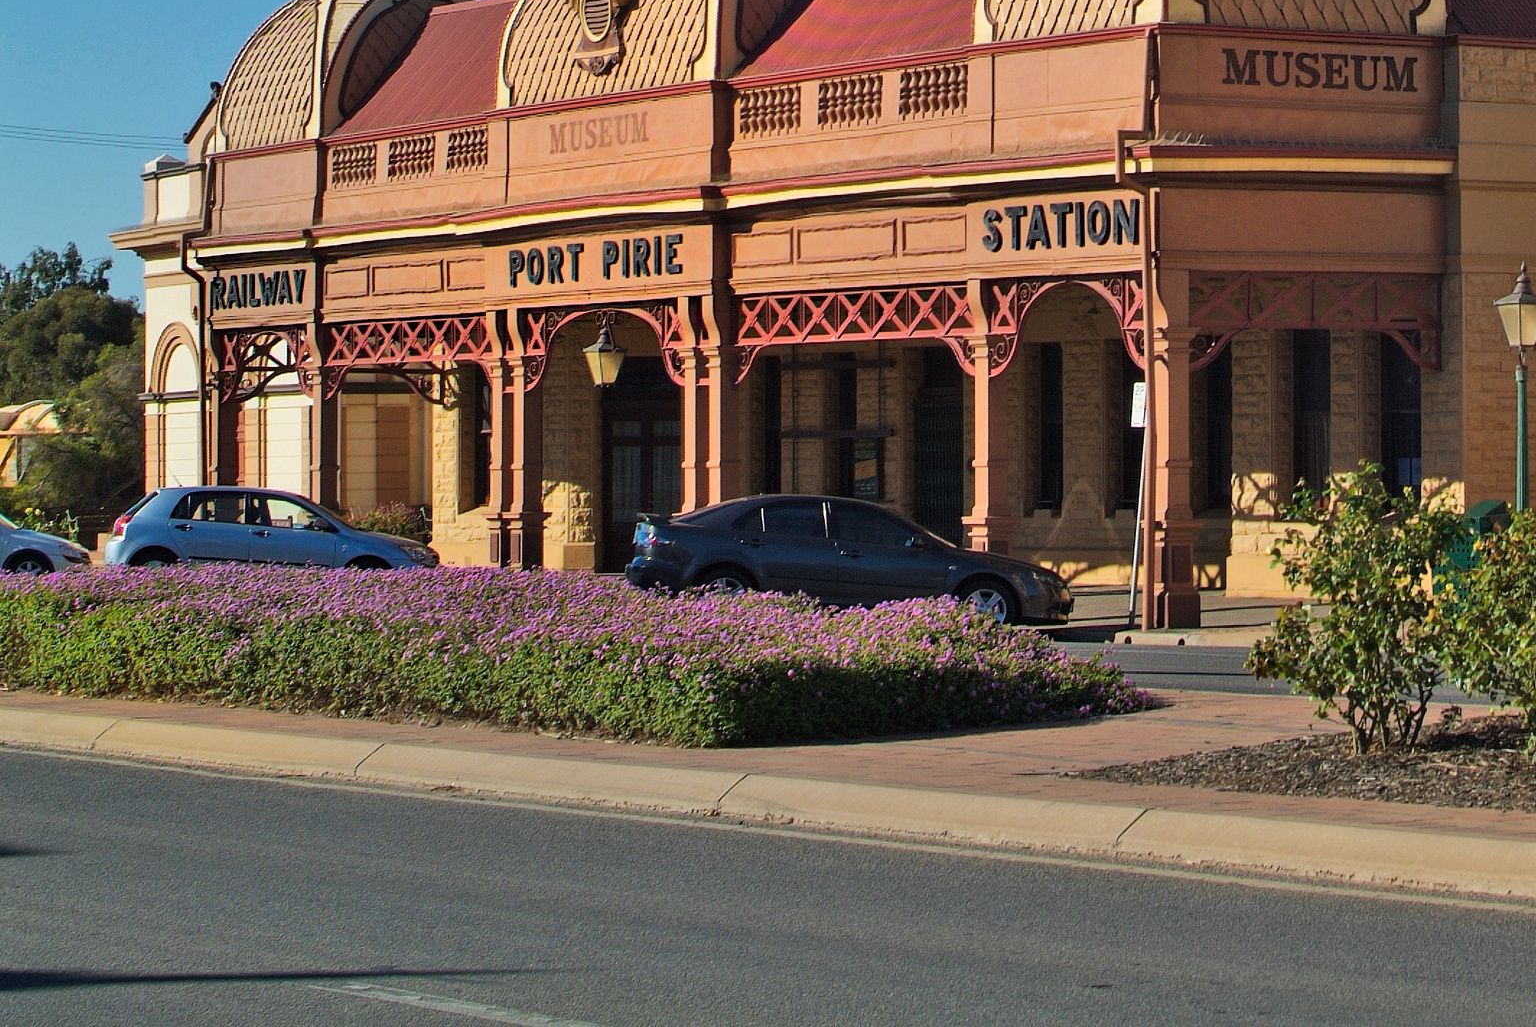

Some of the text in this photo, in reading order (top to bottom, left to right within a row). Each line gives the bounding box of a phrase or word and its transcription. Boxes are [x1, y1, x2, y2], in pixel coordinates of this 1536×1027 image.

[1221, 47, 1419, 94] MUSEUM
[549, 110, 650, 155] MUSEUM
[981, 198, 1140, 253] STATION
[508, 233, 684, 289] PORT PIRIE
[211, 268, 307, 311] RAILWAY
